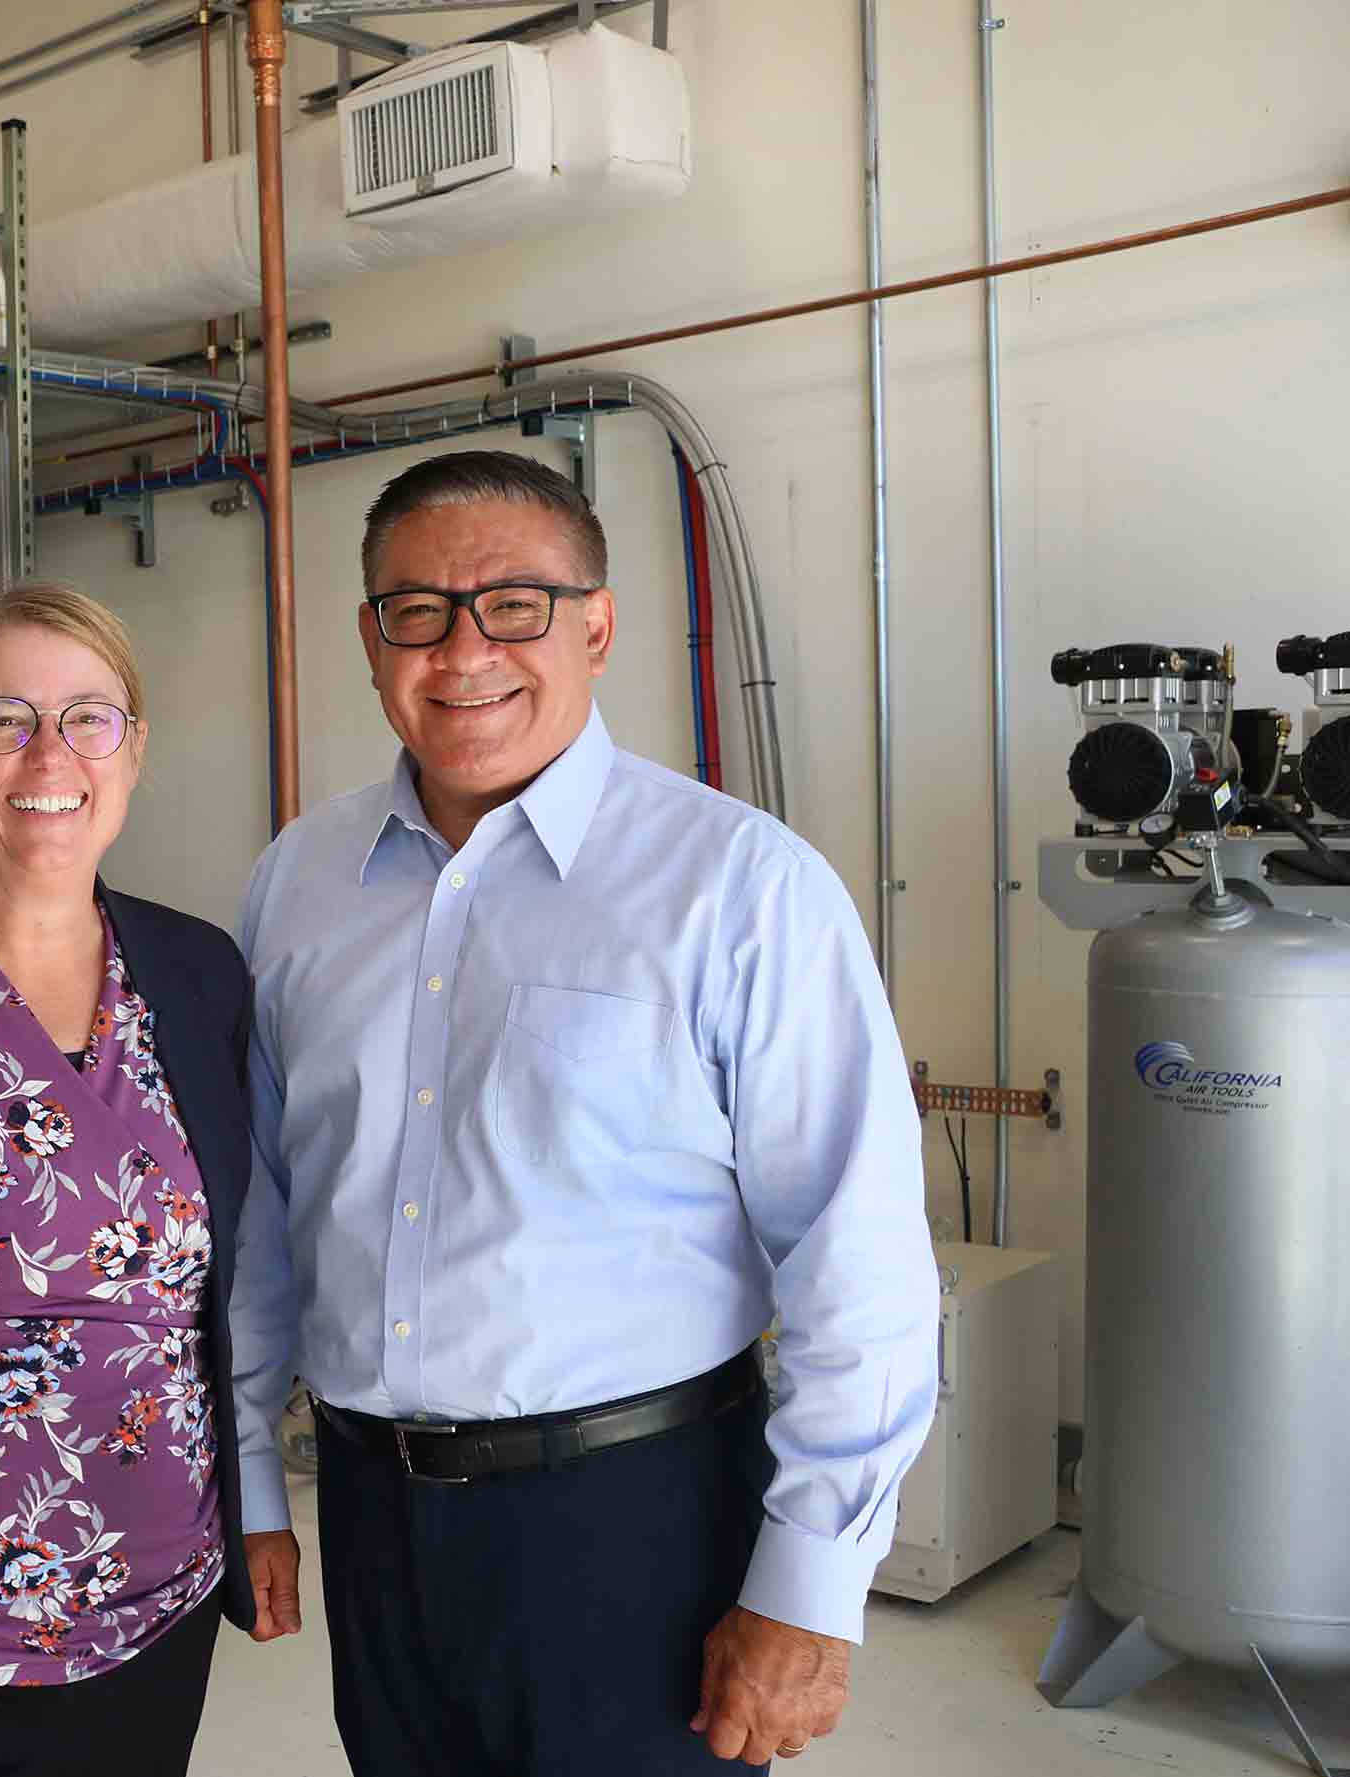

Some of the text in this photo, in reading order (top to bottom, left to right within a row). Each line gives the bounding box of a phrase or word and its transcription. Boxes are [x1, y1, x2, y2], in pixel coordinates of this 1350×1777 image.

[1155, 1062, 1282, 1088] CALIFORNIA
[1186, 1085, 1257, 1099] AIR TOOLS
